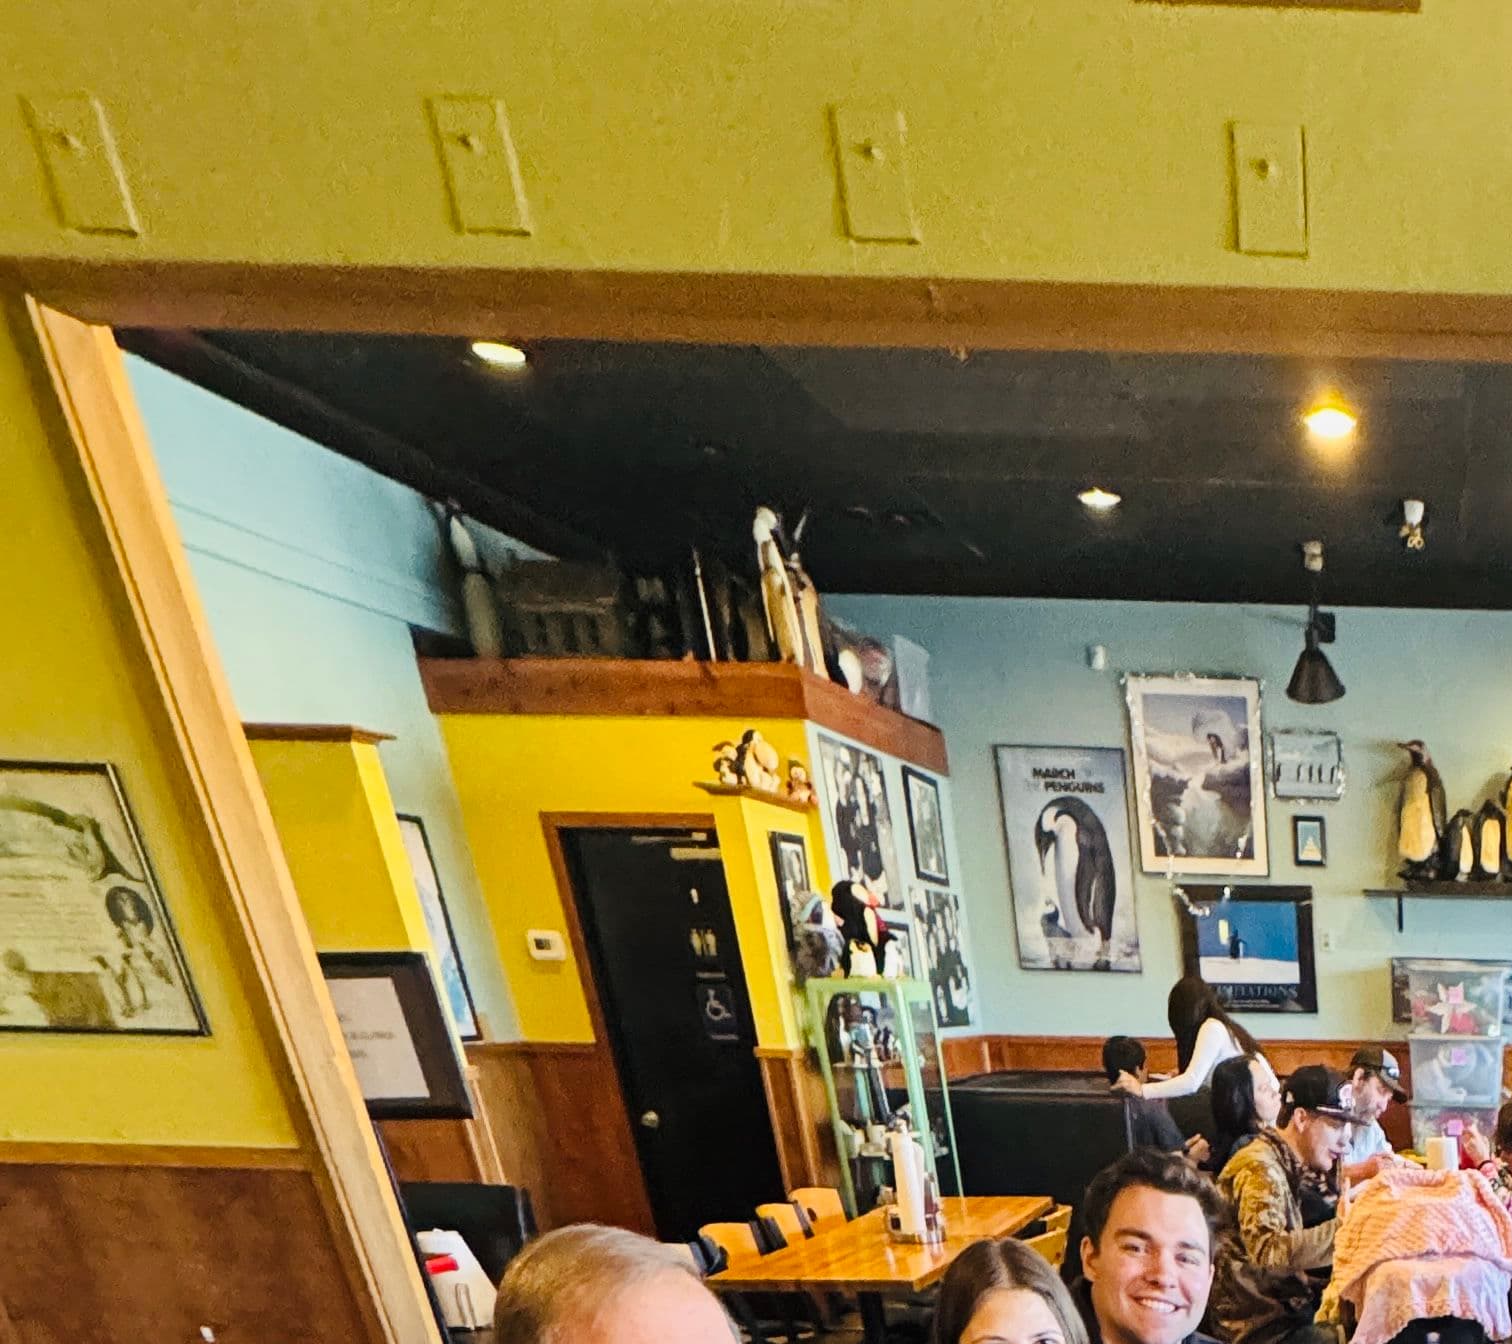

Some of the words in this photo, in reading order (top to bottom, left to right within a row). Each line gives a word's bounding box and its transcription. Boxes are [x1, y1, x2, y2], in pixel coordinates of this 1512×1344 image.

[1032, 767, 1076, 780] MARCH
[1044, 781, 1105, 794] PENGUINS
[1216, 984, 1298, 1000] MITATIONS
